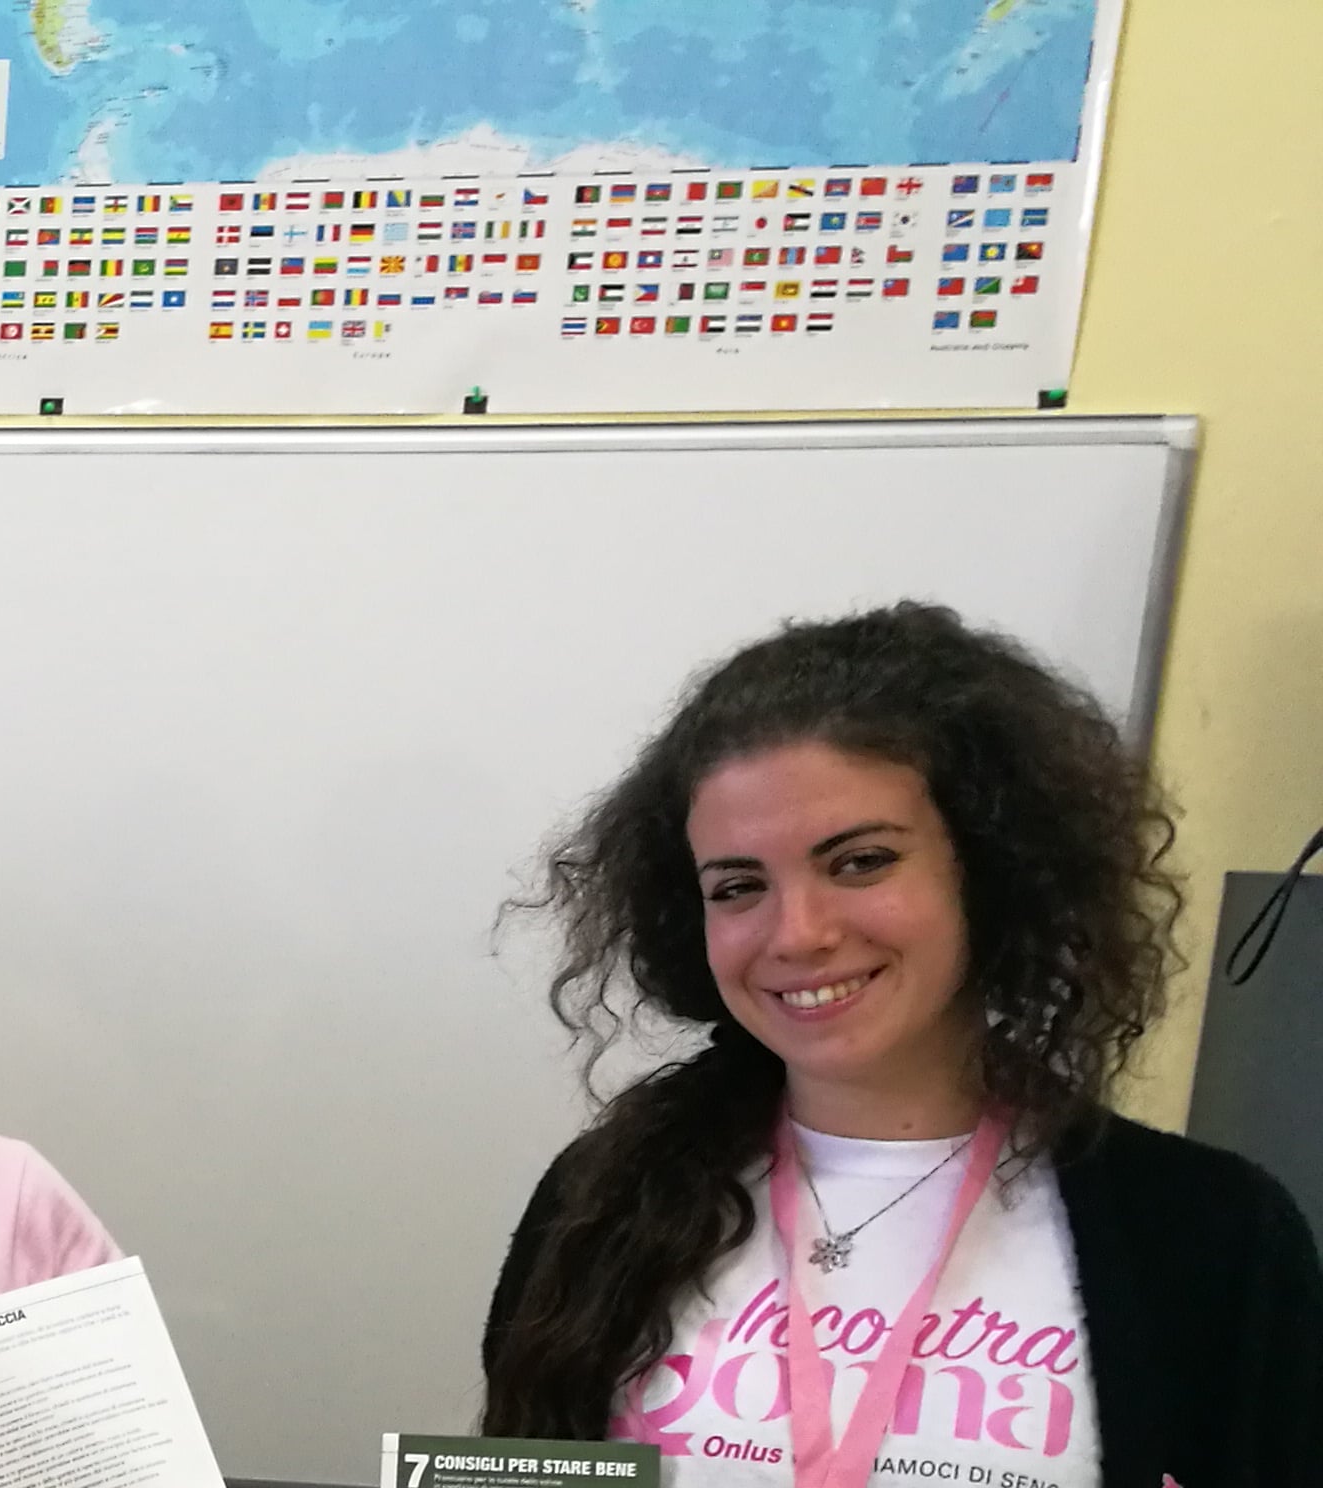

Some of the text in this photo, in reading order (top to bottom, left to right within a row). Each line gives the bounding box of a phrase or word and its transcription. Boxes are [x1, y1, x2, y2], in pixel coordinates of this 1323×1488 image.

[404, 1454, 638, 1488] 7 CONSIGLI PER STARE BENE
[702, 1435, 783, 1464] Onlus
[969, 1466, 993, 1486] DI
